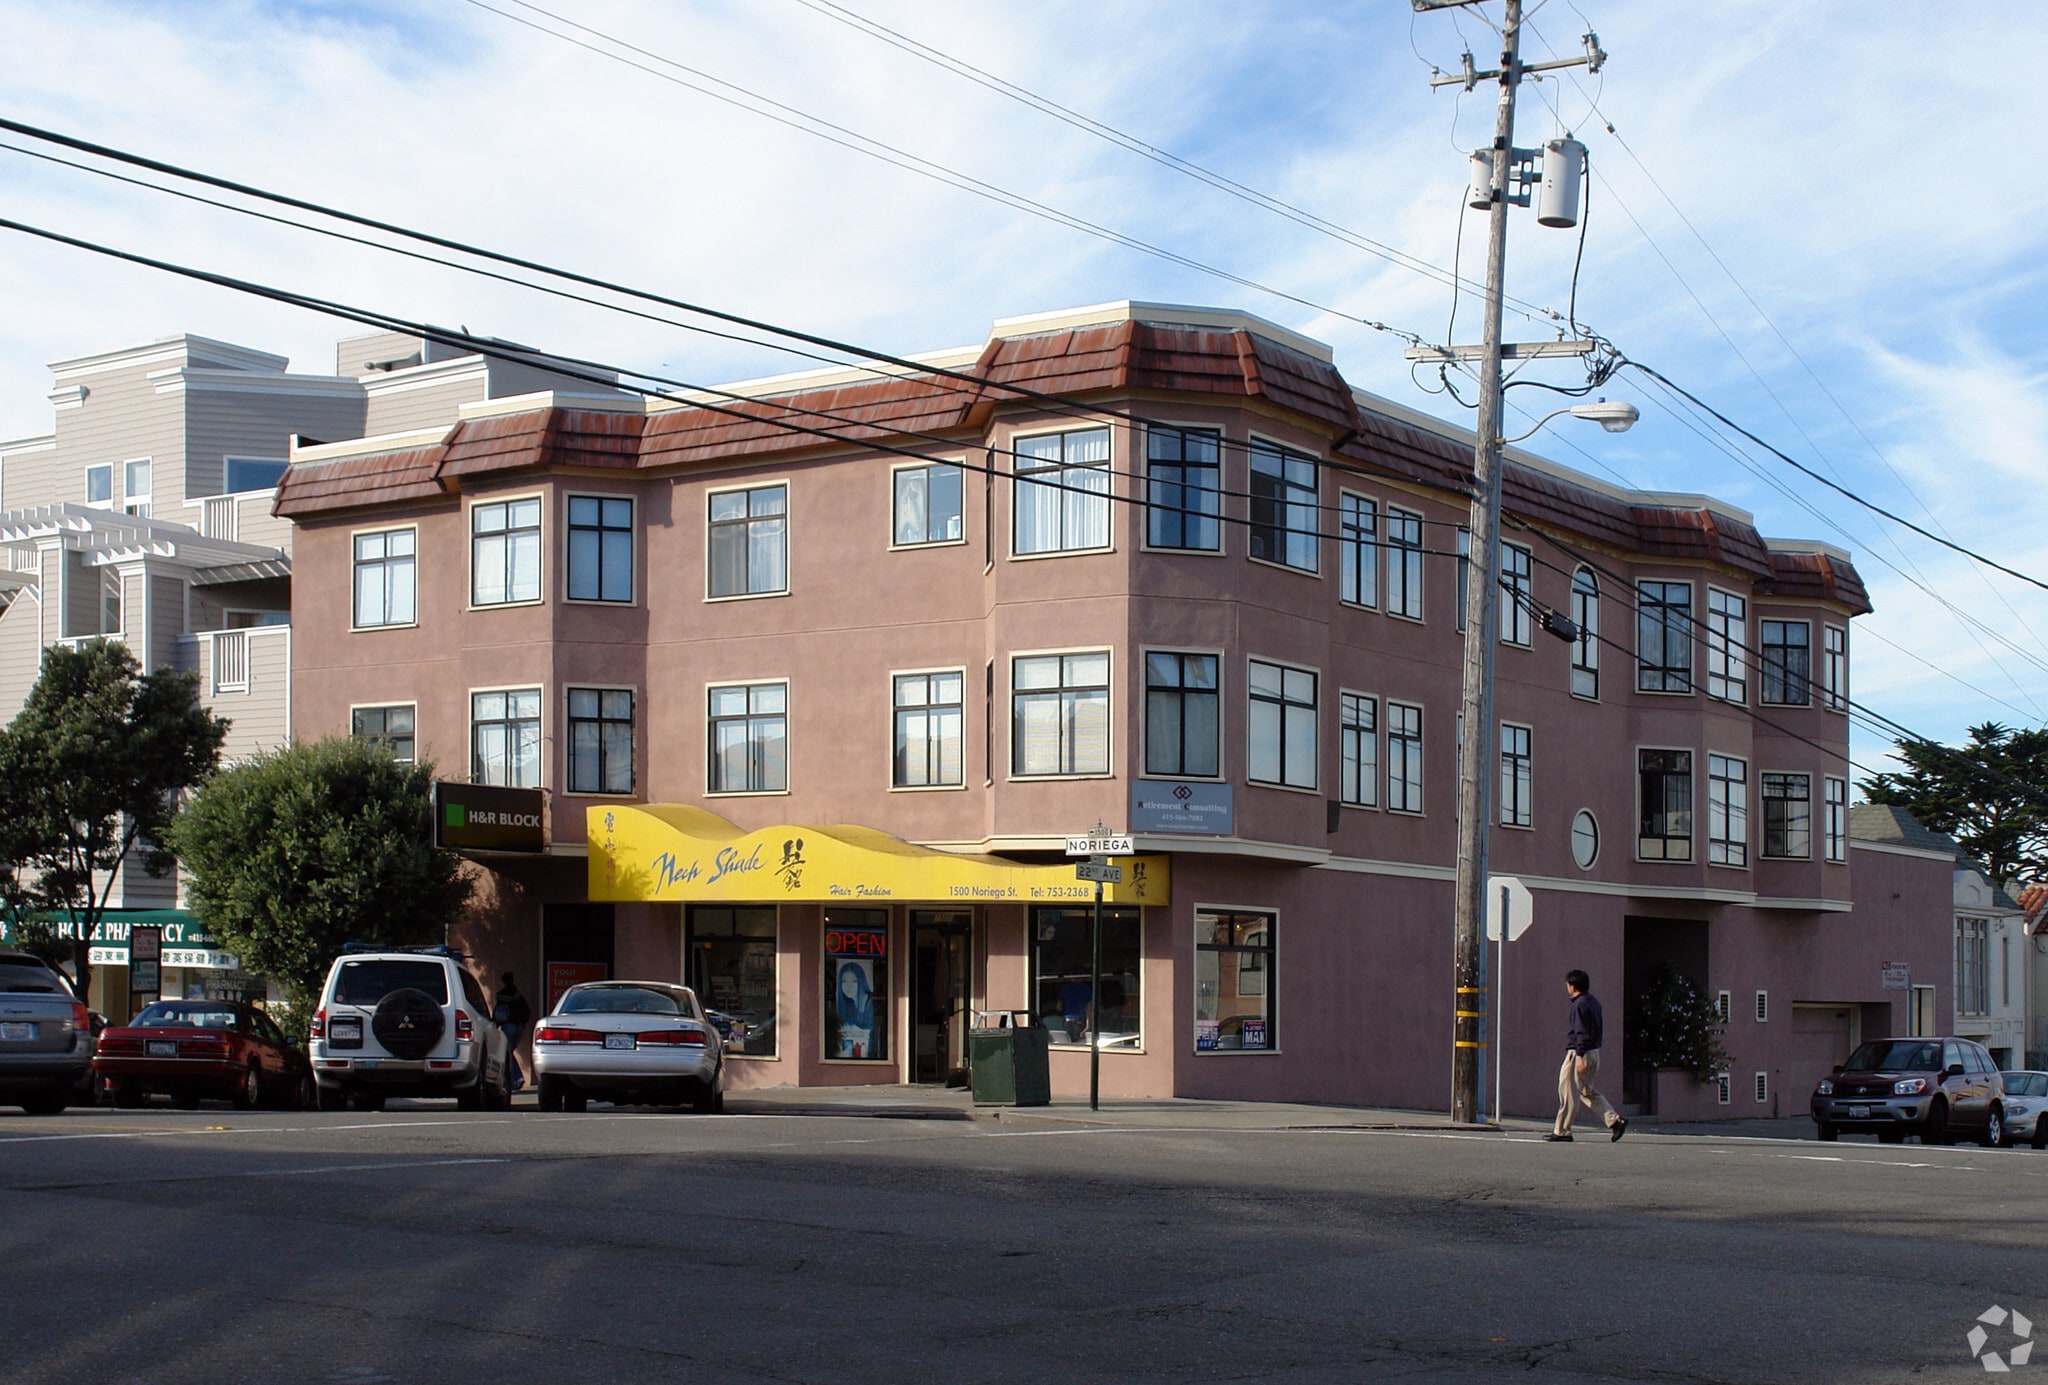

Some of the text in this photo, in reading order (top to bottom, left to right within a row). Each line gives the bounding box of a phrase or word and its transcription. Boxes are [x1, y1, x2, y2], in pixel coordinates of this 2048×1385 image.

[1137, 801, 1227, 814] Retirement Consulting
[469, 811, 540, 828] H&R BLOCK
[1069, 840, 1130, 851] NORIEGA
[706, 843, 766, 884] Shade
[1102, 869, 1120, 880] AVE
[829, 884, 891, 898] Hair Fashion
[949, 886, 1089, 898] 1500 Noriega St. Tel: 753-2368
[58, 922, 103, 940] HOUE
[106, 922, 184, 942] PHACY
[825, 931, 885, 954] OPEN
[554, 967, 576, 976] your
